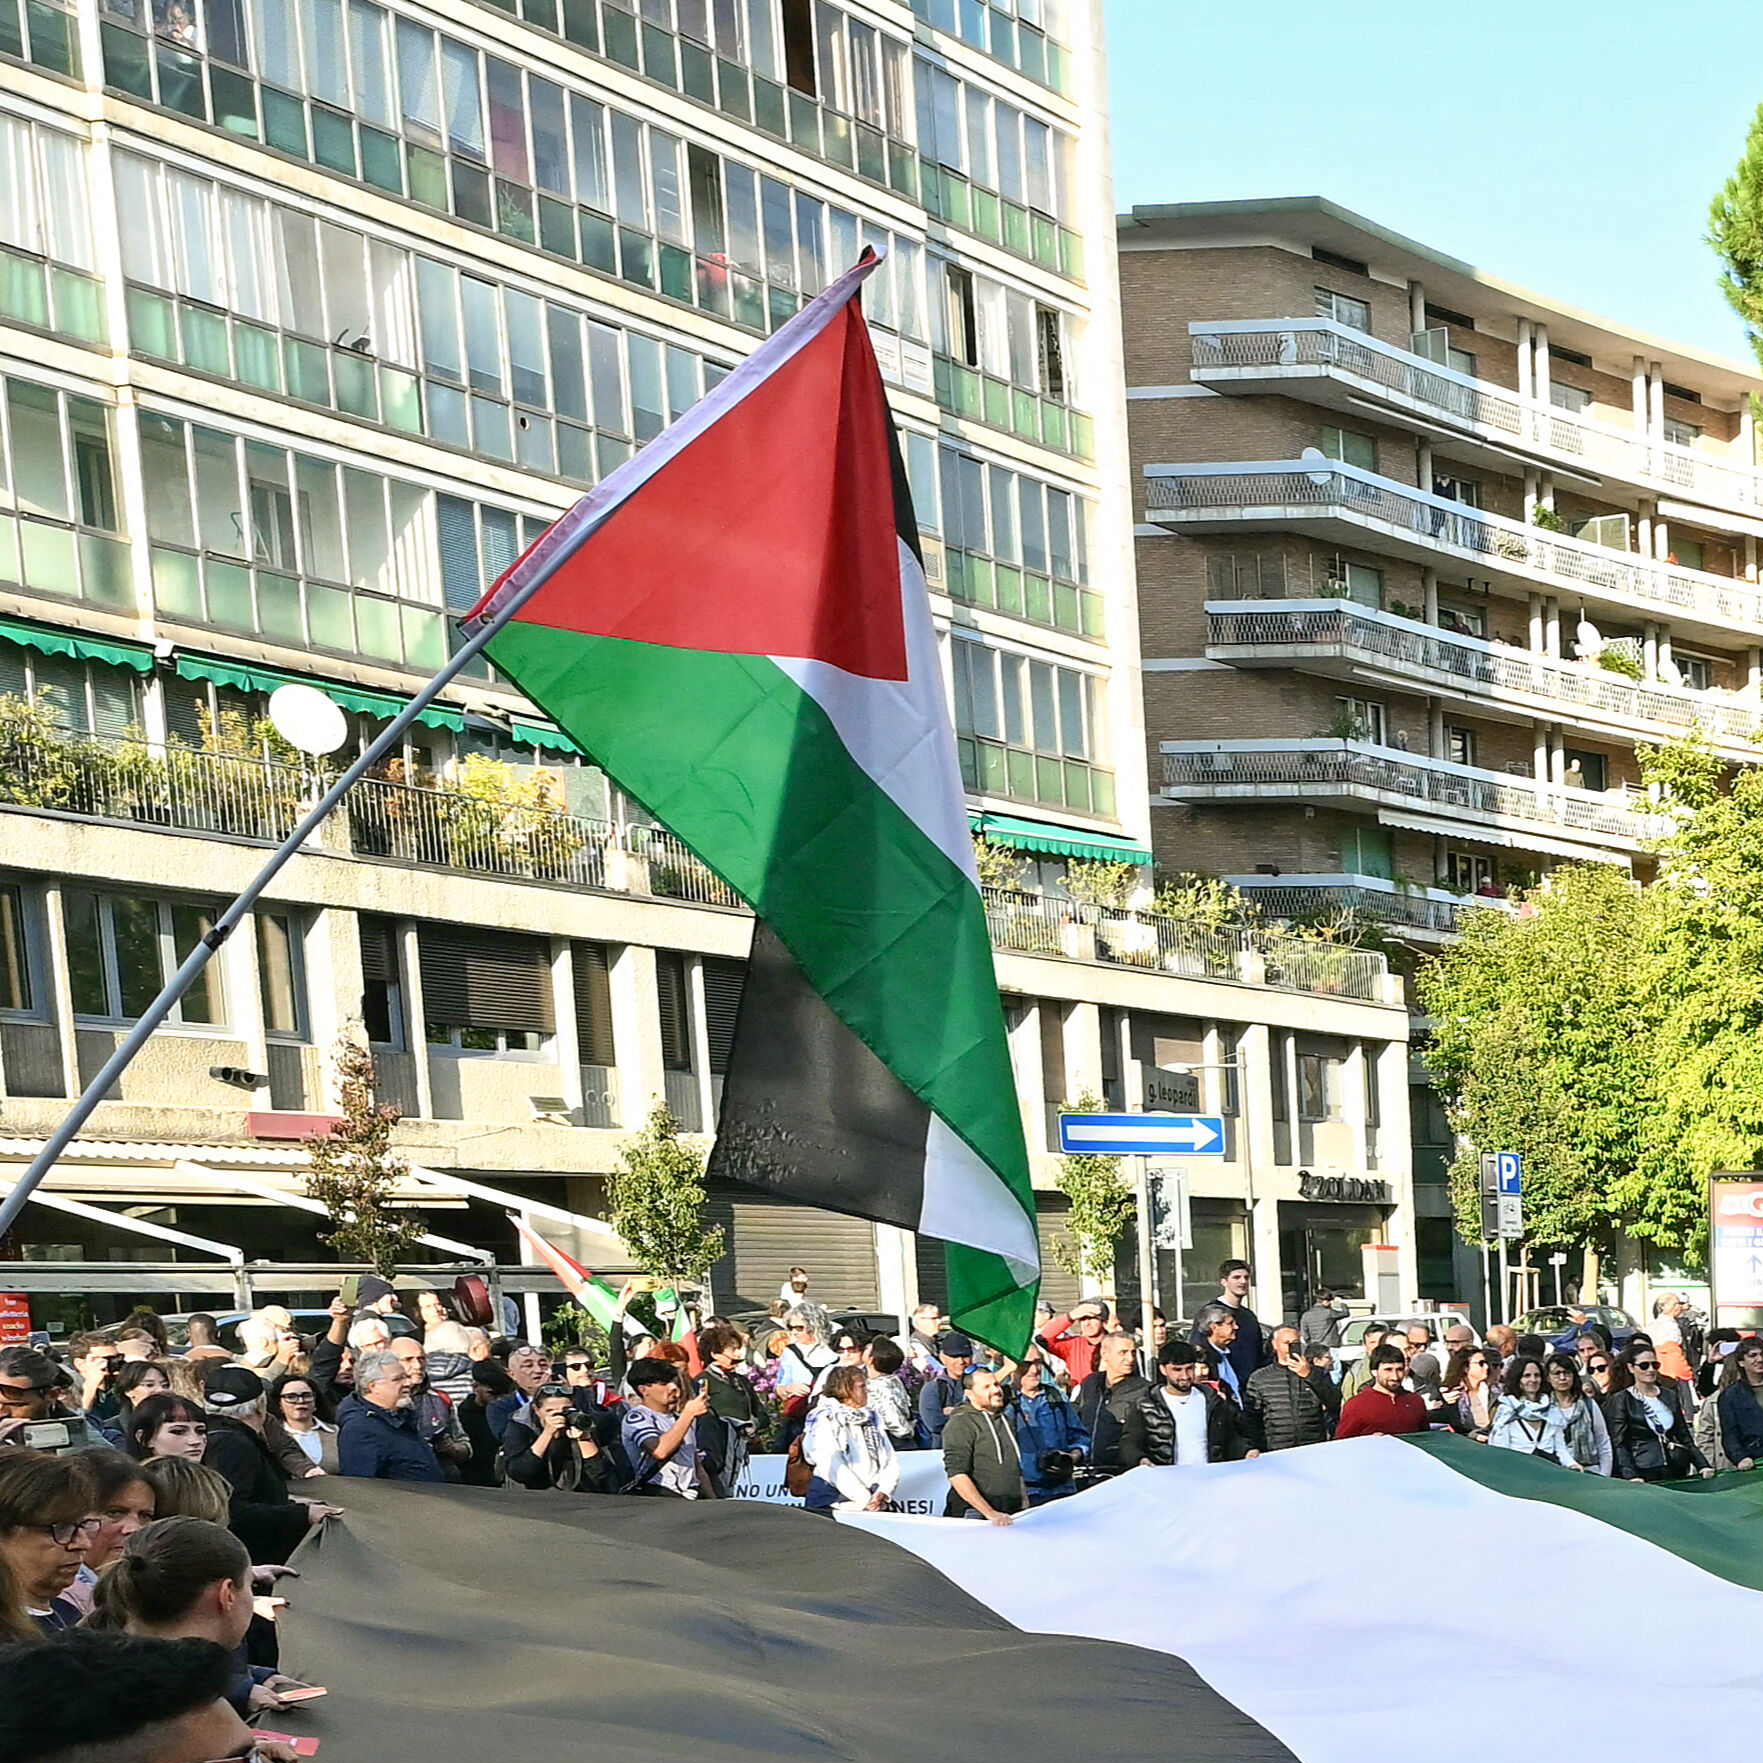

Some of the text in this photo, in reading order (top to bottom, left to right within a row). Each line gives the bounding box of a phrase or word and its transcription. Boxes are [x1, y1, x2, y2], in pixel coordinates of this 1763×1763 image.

[1158, 1081, 1196, 1107] leopardi
[1501, 1155, 1517, 1191] P
[891, 1500, 934, 1514] NESI
